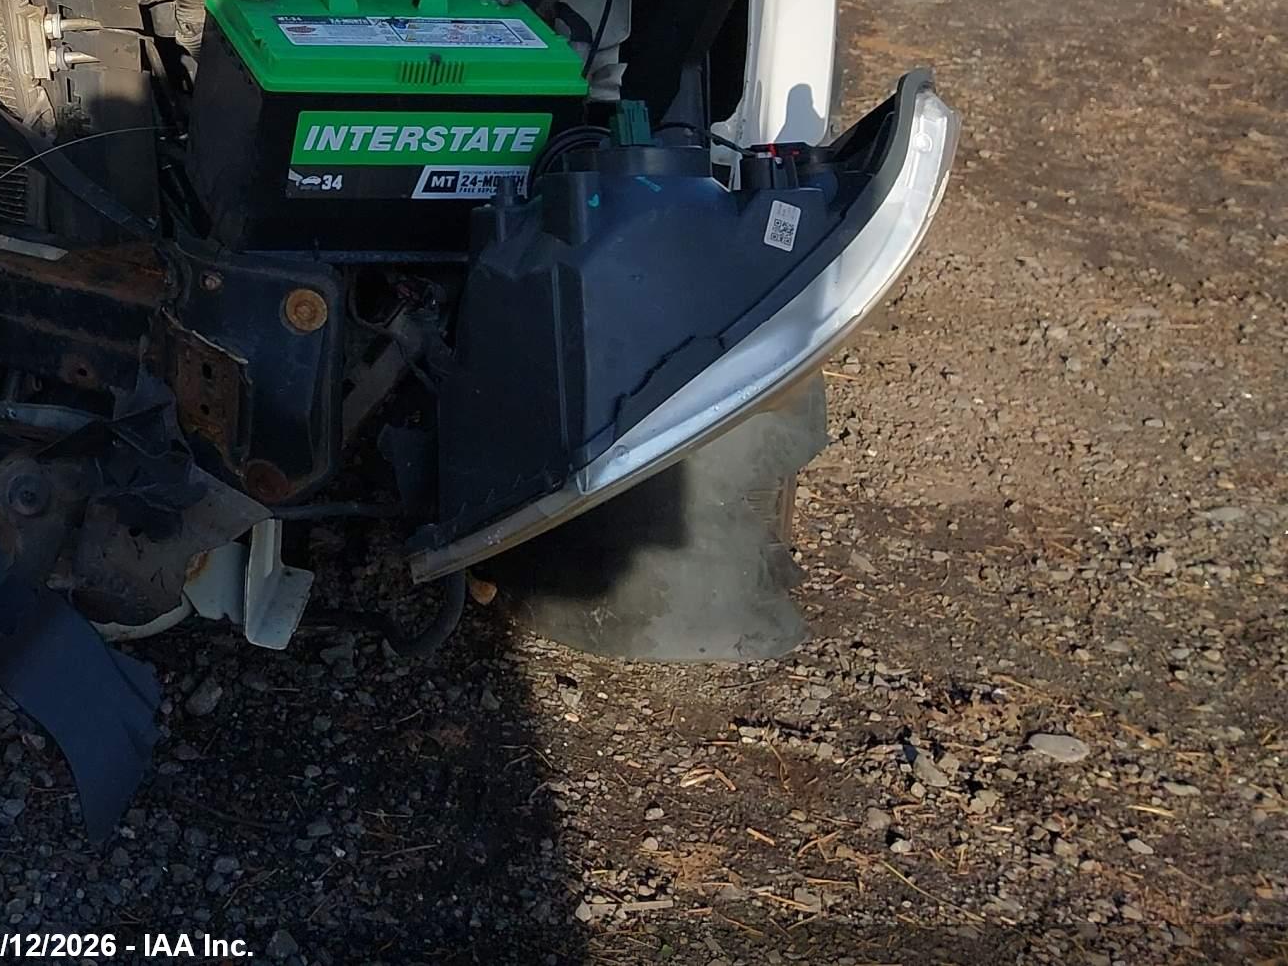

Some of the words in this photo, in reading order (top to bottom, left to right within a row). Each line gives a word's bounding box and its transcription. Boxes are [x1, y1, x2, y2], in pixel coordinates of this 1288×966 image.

[303, 125, 541, 153] INTERSTATE
[321, 174, 343, 190] 34
[430, 175, 456, 188] MT
